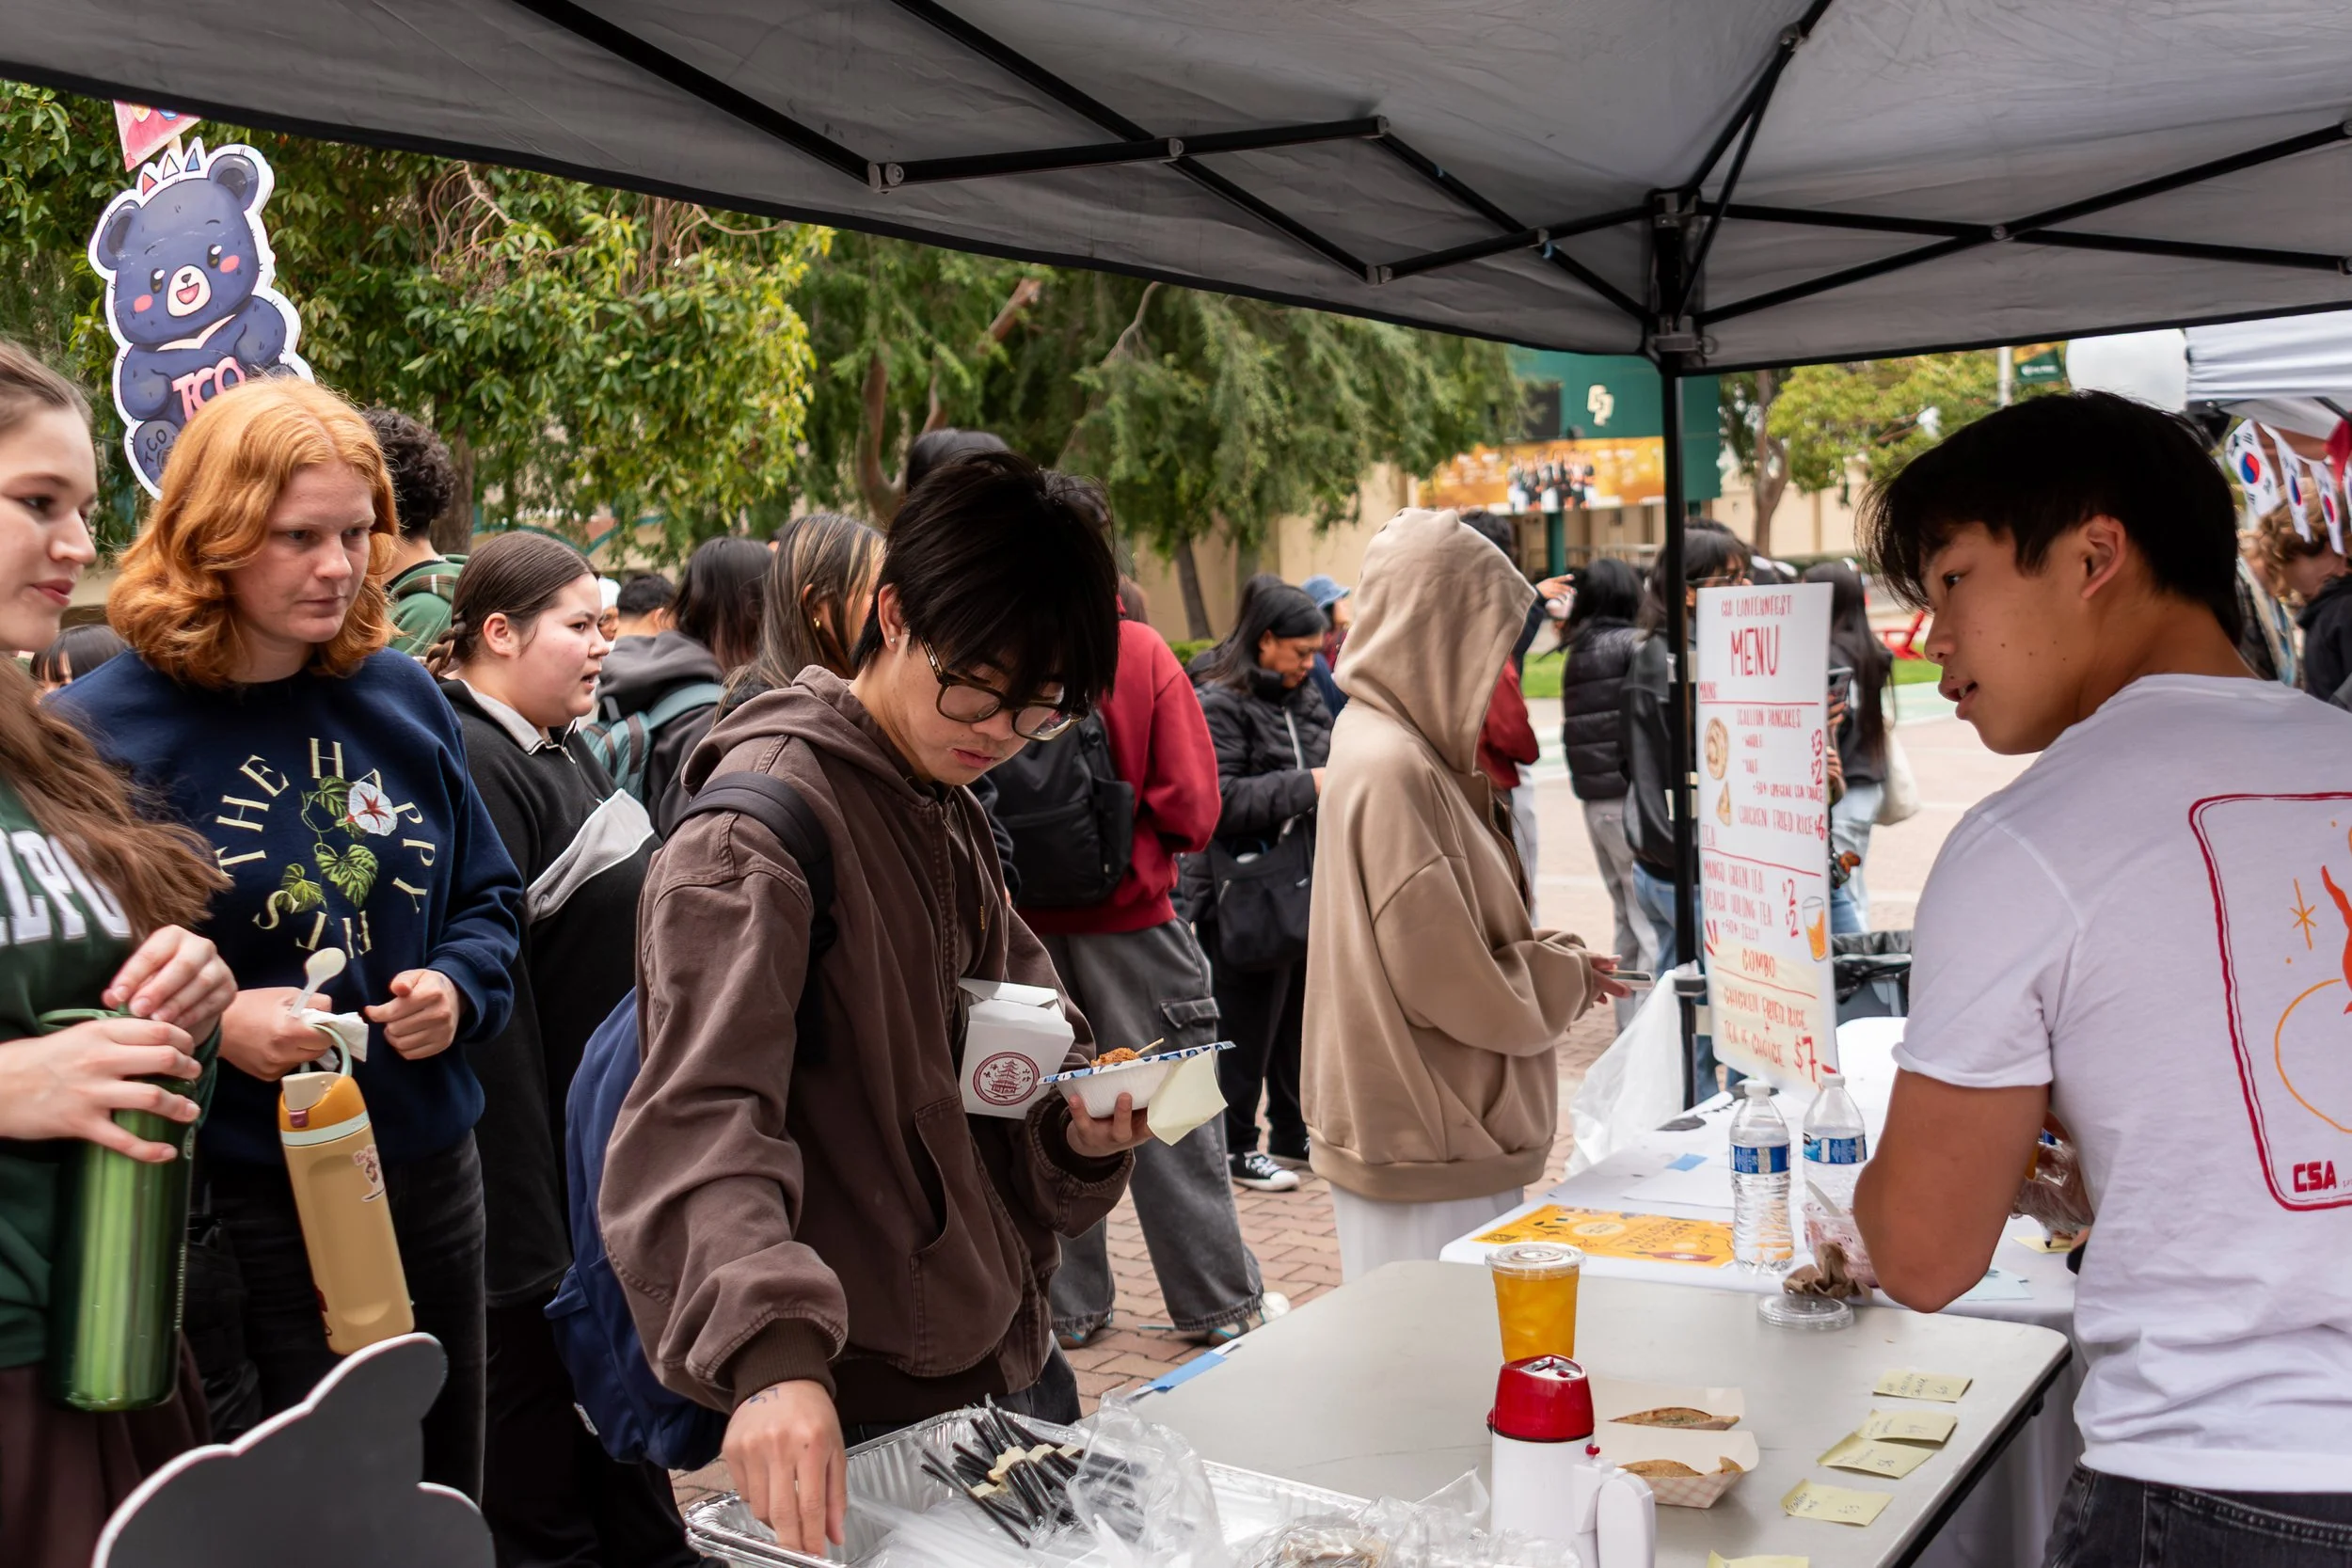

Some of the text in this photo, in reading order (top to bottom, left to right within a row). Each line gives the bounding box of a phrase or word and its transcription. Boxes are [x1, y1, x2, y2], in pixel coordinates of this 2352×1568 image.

[1730, 625, 1780, 677] MENU
[1811, 728, 1822, 756] $3
[1811, 758, 1822, 785] $2
[215, 754, 290, 878] THE
[1739, 804, 1768, 828] CHICKEN
[1772, 809, 1792, 832] FRIED
[1796, 813, 1813, 835] RICE
[1703, 859, 1797, 907] MANGO GREEN TEA $2
[1759, 900, 1772, 927] TEA
[1786, 909, 1799, 938] $2
[1741, 947, 1776, 979] COMBO
[1724, 986, 1758, 1013] CHICKEN
[1761, 996, 1785, 1023] FRIED
[1794, 1034, 1817, 1083] $7
[2293, 1161, 2337, 1193] CSA
